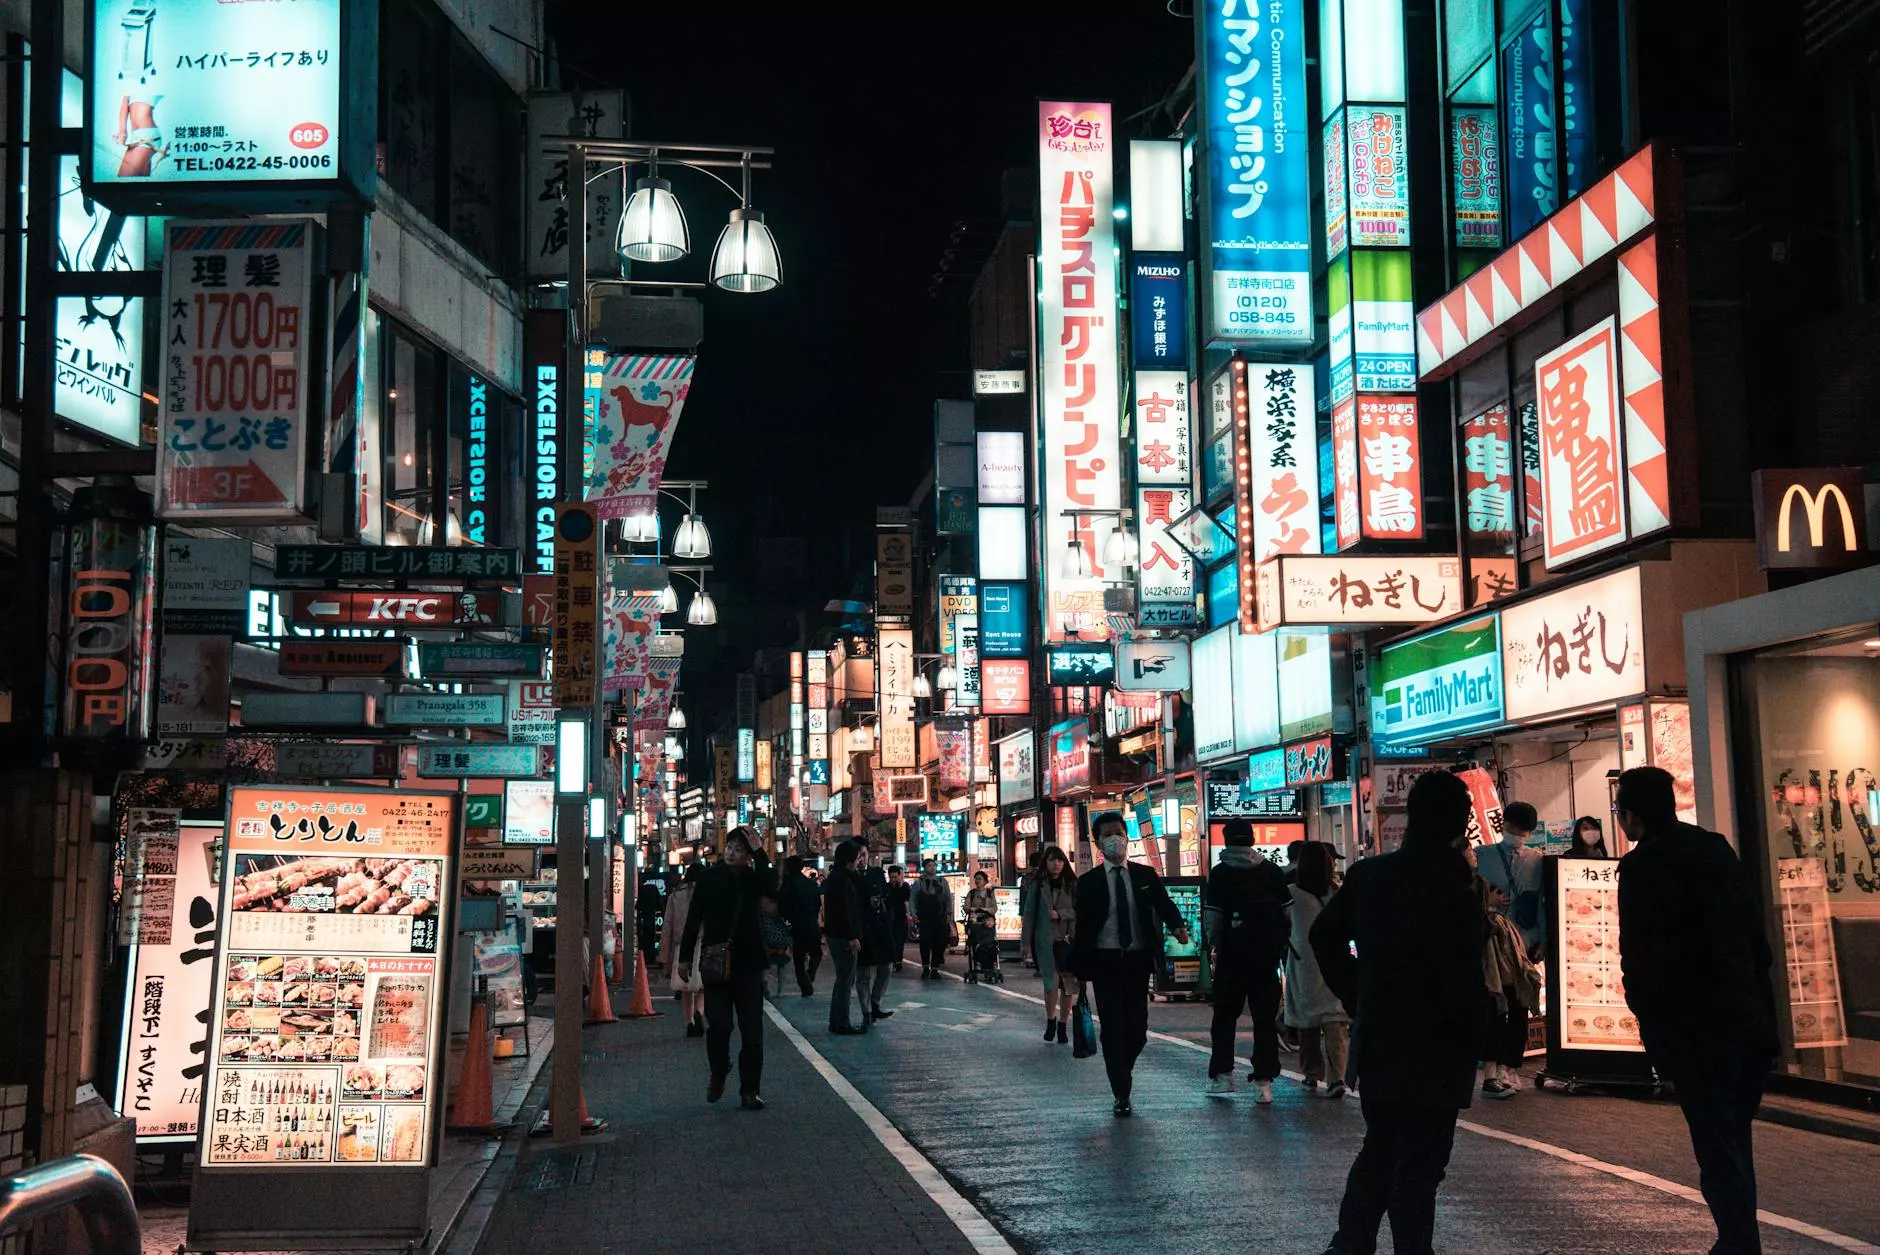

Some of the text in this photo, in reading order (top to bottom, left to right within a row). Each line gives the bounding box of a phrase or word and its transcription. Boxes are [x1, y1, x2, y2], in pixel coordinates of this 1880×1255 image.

[1270, 28, 1288, 154] Communication
[293, 129, 323, 143] 605
[174, 155, 331, 172] TEL:0422-45-0006
[1358, 220, 1397, 233] 1000
[1138, 265, 1180, 277] MIZUHO
[1227, 277, 1295, 290] 吉祥寺南口店
[1237, 295, 1287, 309] (0120)
[194, 292, 298, 348] 1700円
[1153, 295, 1167, 356] みずほ銀行
[1229, 311, 1295, 323] 058-845
[1358, 321, 1410, 333] FamilyMart
[193, 354, 297, 412] 1000円
[172, 417, 292, 451] ことぶき
[1137, 391, 1176, 474] 古本
[536, 366, 557, 575] EXCELSIOR CAFF
[1363, 430, 1417, 533] 串鳥
[211, 471, 251, 499] 3F
[1142, 490, 1179, 570] 買入
[287, 551, 509, 576] 井ノ頭ビル御案内
[947, 597, 971, 606] DVD
[1144, 586, 1191, 596] 0422-47-0727
[1327, 568, 1446, 614] ねぎし
[368, 598, 440, 620] KFC
[1144, 608, 1192, 623] 大竹ビル
[1536, 605, 1629, 692] ねぎし
[1405, 665, 1493, 719] FamilyMart
[467, 700, 488, 710] 358
[434, 752, 470, 769] 理髪
[269, 813, 366, 843] とりとん
[927, 831, 956, 841] DVD
[215, 1106, 265, 1126] 日本酒
[342, 1111, 377, 1127] ビール
[213, 1133, 269, 1155] 果実酒
